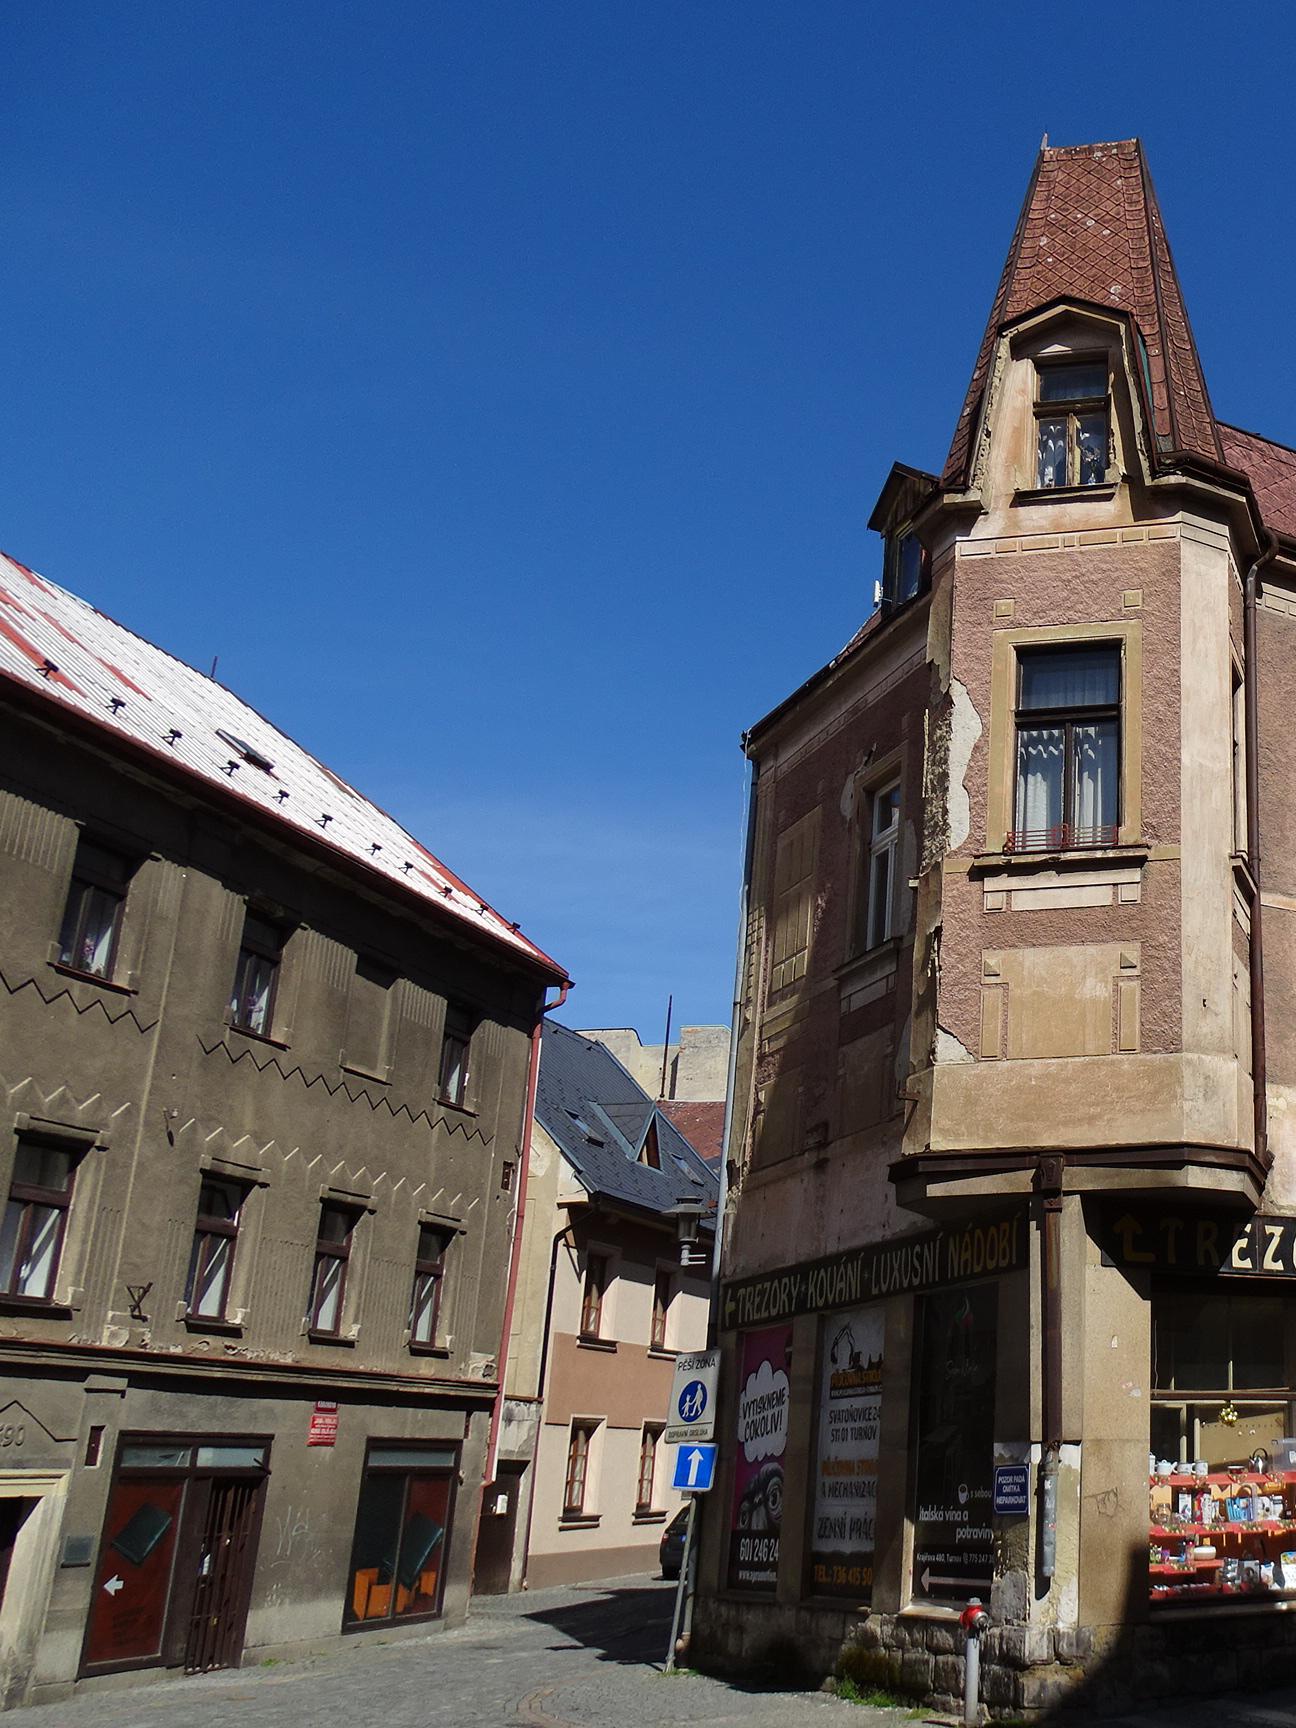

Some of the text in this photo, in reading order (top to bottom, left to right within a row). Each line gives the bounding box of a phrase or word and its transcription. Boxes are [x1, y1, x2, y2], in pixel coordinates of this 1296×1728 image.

[737, 1214, 1022, 1324] TREZORY KOVÁNÍ LUXUSNÍ NÁDOBÍ
[678, 1357, 695, 1371] PĚŠÍ
[743, 1387, 786, 1419] VYTISKNEME
[744, 1409, 783, 1442] COKOLIV!
[974, 1486, 992, 1498] sebou
[919, 1504, 969, 1521] Italská vína a
[955, 1522, 994, 1544] potraviny
[739, 1537, 753, 1561] 601
[753, 1537, 769, 1562] 246
